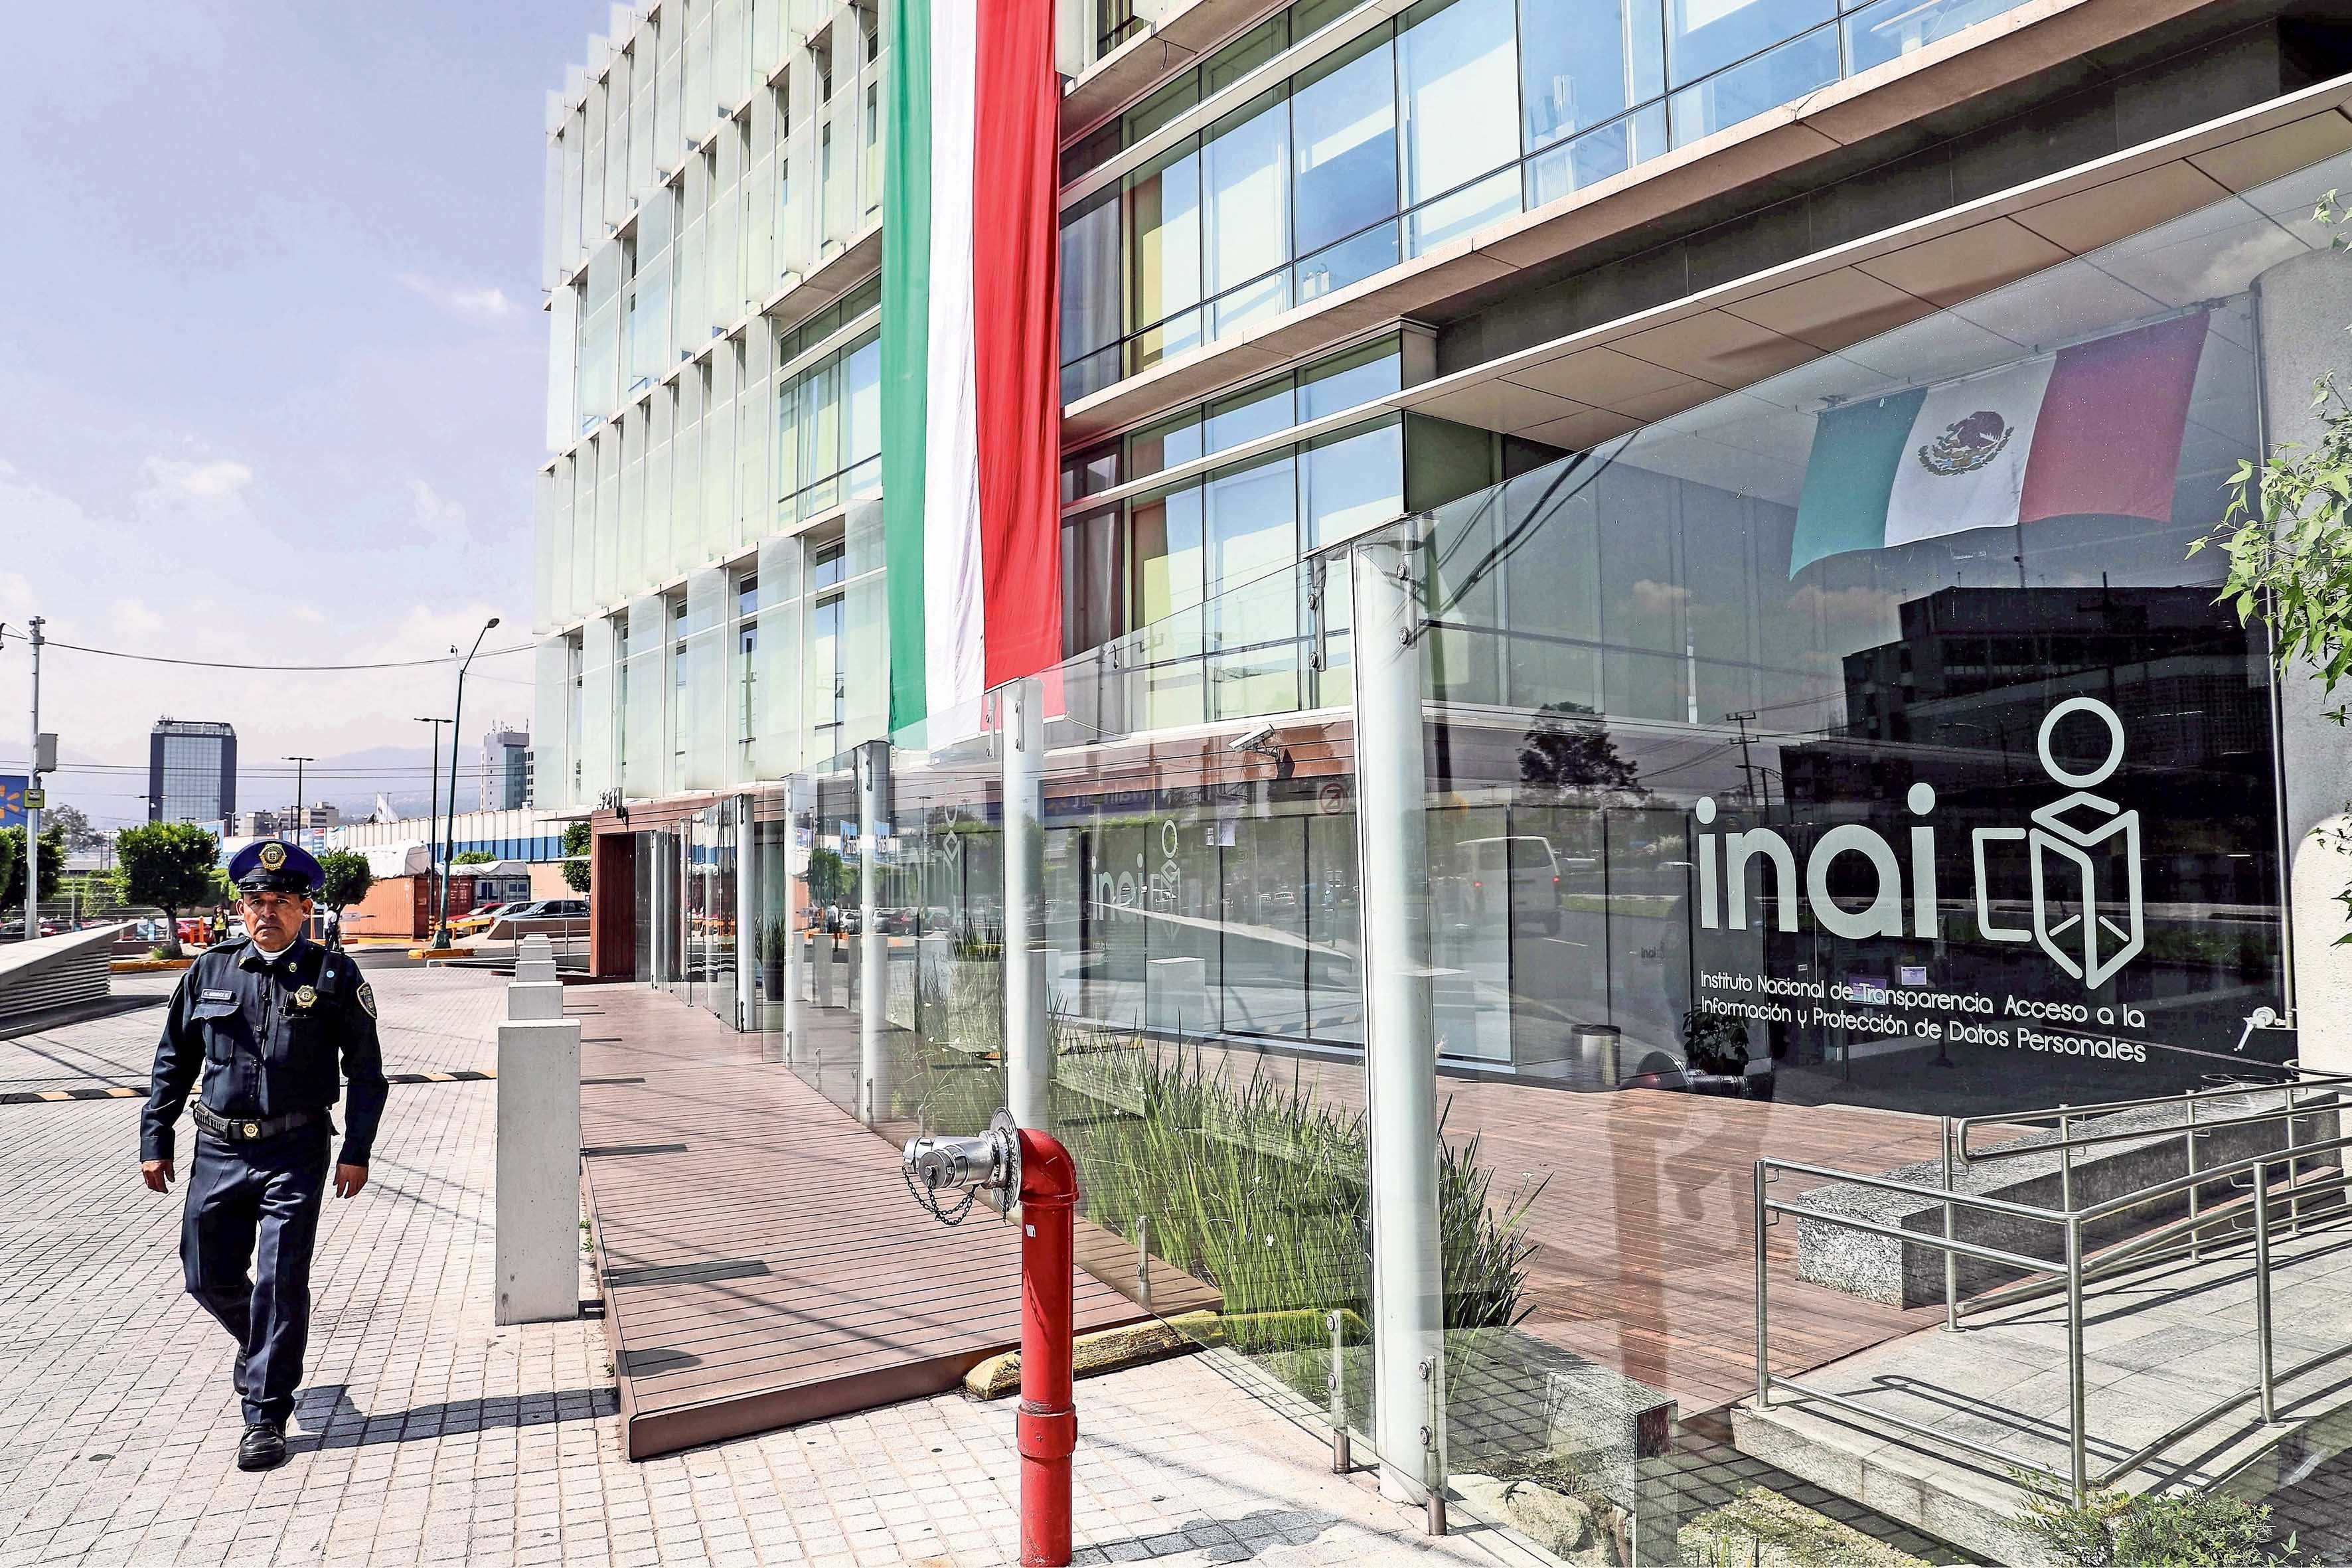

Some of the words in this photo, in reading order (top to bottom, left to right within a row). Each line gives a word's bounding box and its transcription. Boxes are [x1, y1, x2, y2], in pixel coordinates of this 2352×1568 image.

[1695, 782, 1939, 939] inai
[1701, 970, 1753, 992] Instituto
[1757, 975, 1825, 998] Nacional
[1830, 981, 1854, 1001] de
[1859, 982, 1994, 1014] Transparencia
[2005, 995, 2088, 1022] Acceso
[2096, 1007, 2114, 1025] a
[2122, 1003, 2146, 1028] la
[1701, 995, 1792, 1022] Información
[1797, 1010, 1807, 1029] y
[1813, 1006, 1908, 1036] Protección
[1915, 1018, 1942, 1040] de
[1949, 1020, 2009, 1047] Datos
[2017, 1027, 2146, 1063] Personales
